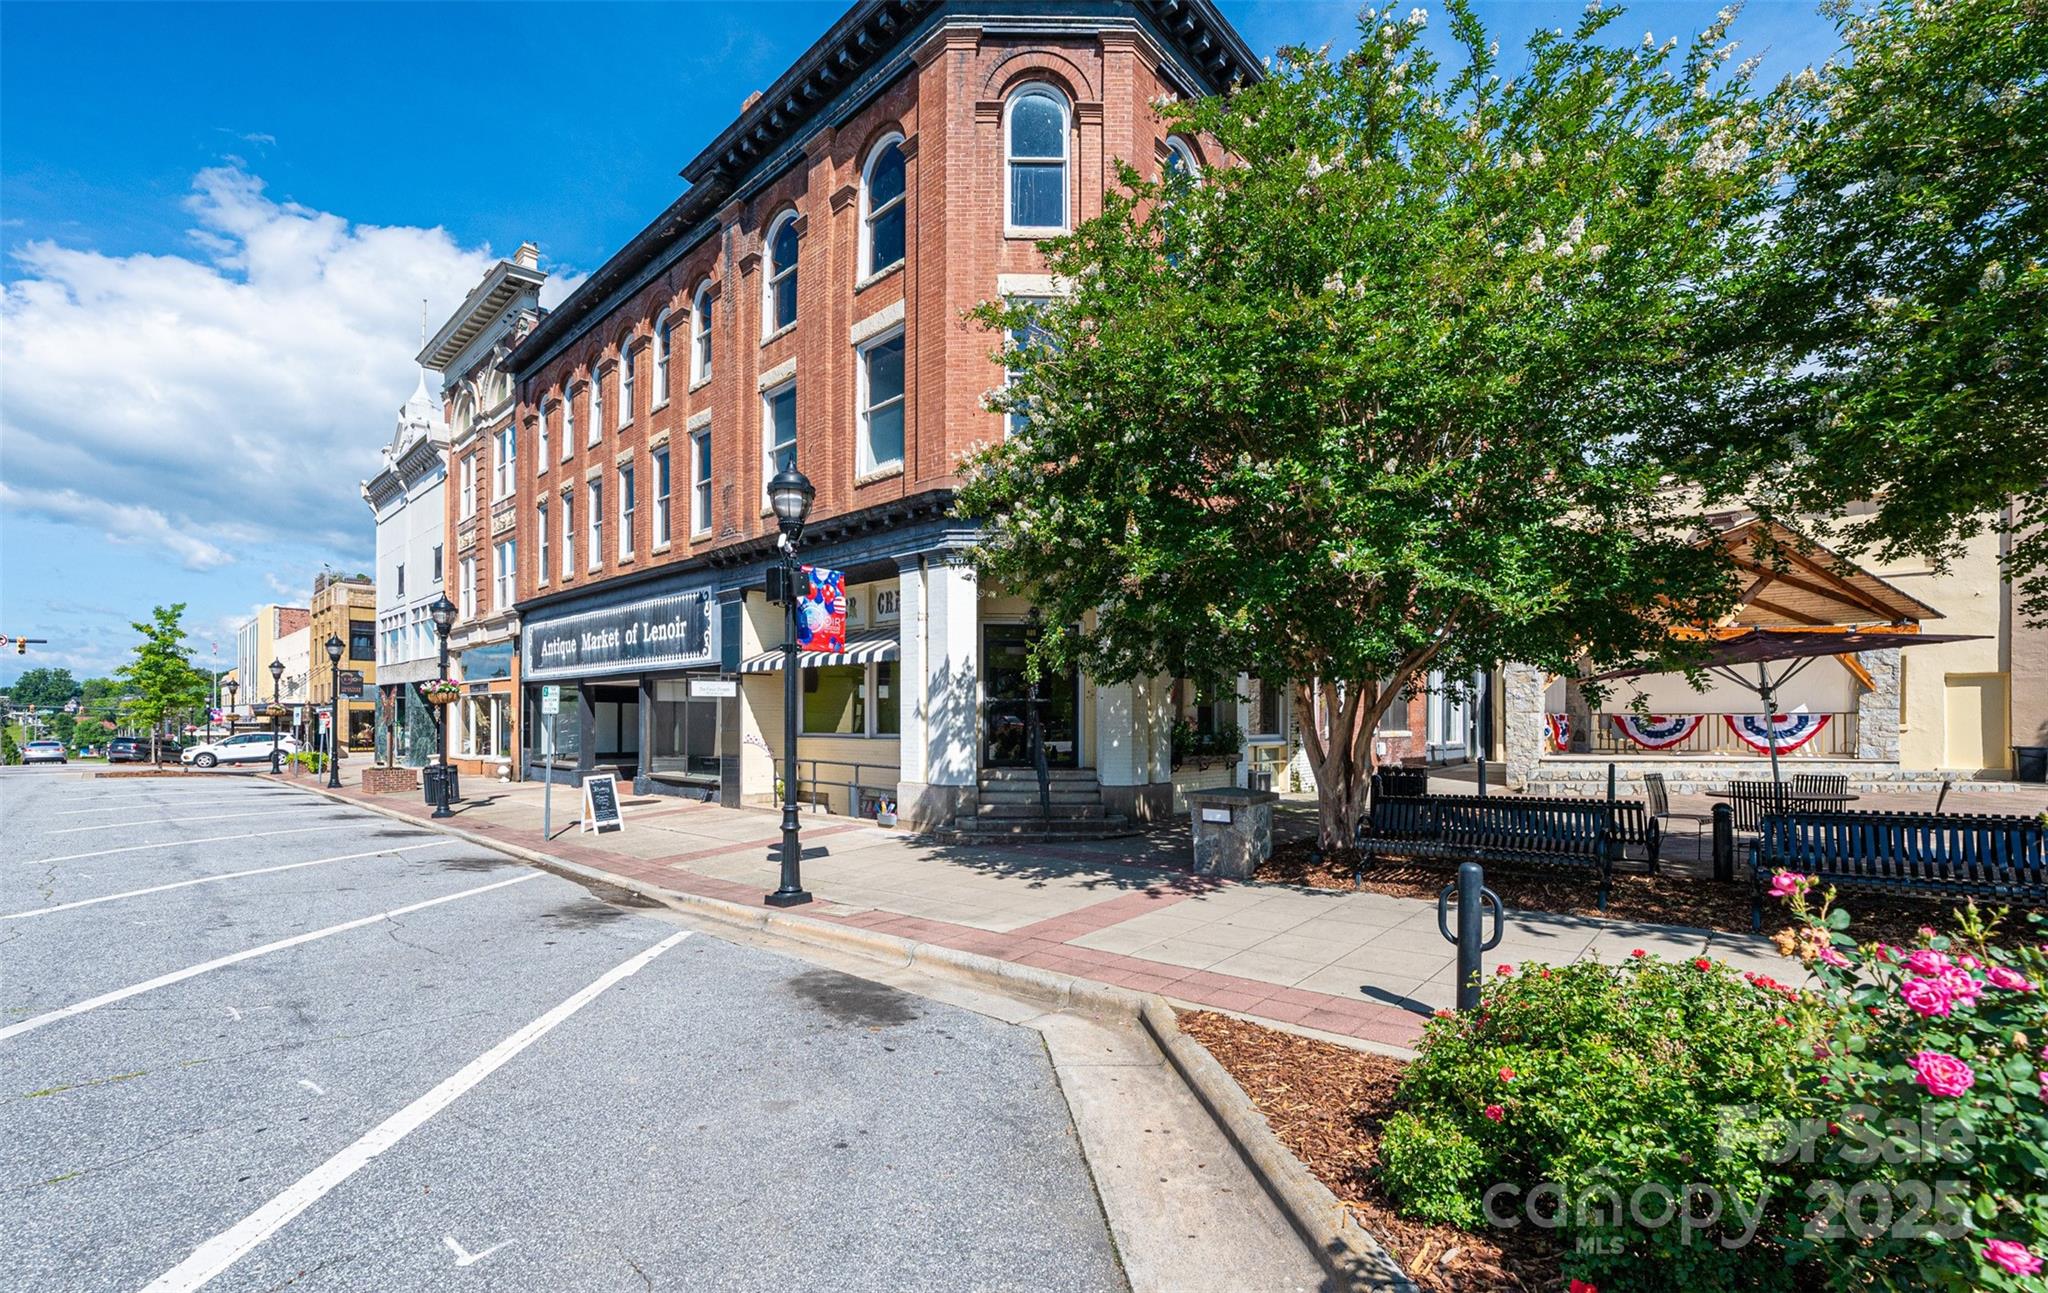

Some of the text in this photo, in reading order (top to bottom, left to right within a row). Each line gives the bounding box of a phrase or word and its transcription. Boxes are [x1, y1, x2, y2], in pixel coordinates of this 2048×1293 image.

[541, 616, 688, 660] Antique Market of Lenoir
